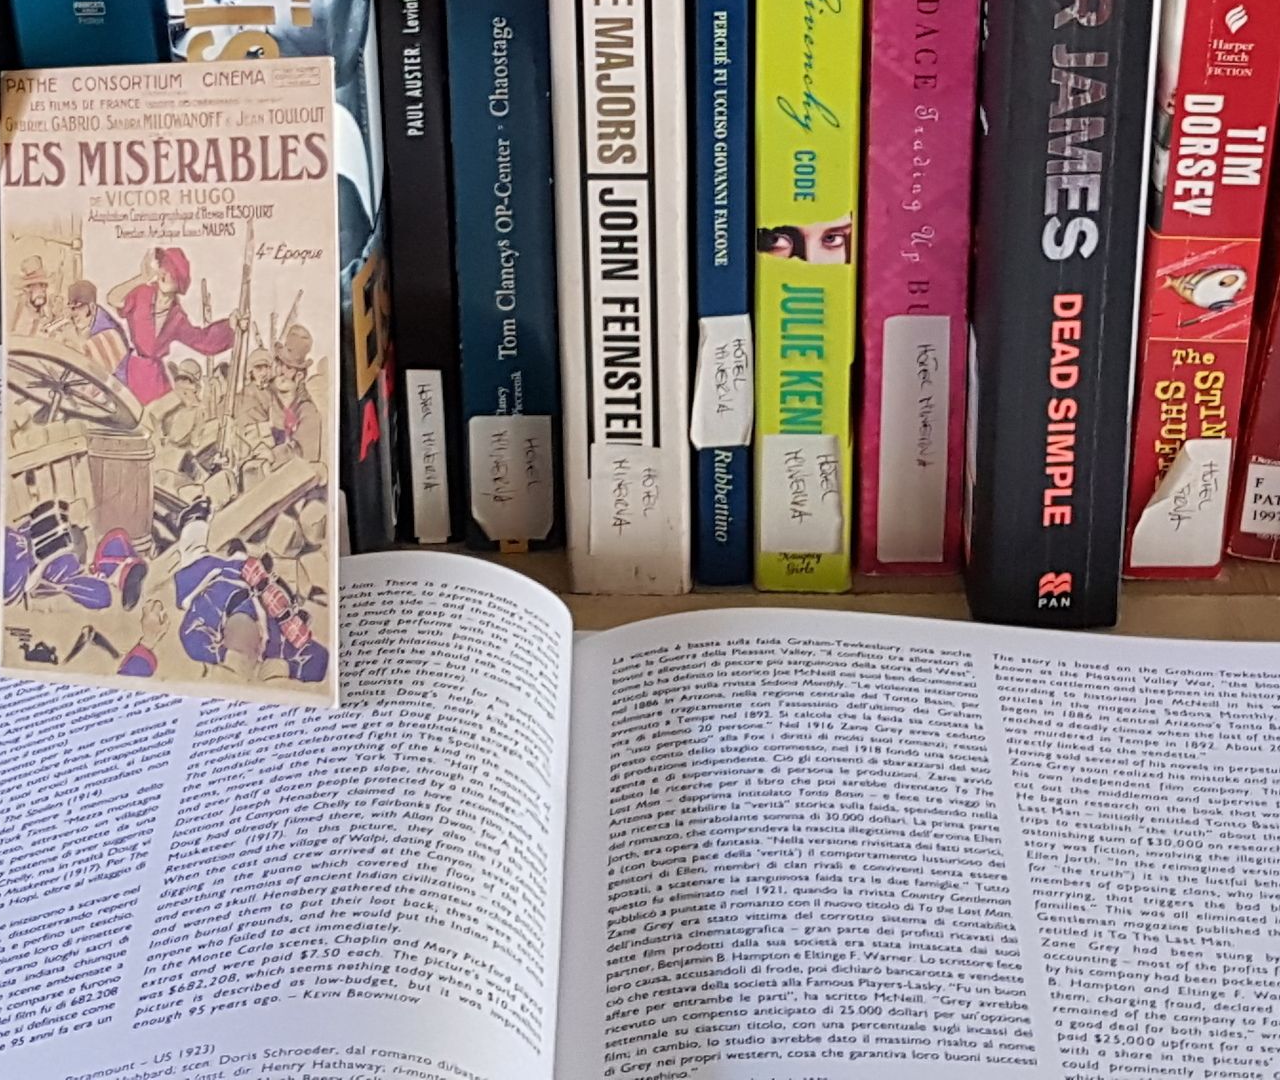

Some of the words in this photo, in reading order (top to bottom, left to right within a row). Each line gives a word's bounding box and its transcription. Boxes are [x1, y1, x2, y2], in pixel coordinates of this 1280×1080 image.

[489, 16, 512, 117] Chaostage
[712, 11, 731, 65] PERCHÉ
[1215, 52, 1249, 64] Torch
[72, 74, 183, 91] CONSORTIUM
[203, 70, 265, 87] CINEMA
[100, 99, 140, 108] FRANCE
[594, 17, 637, 166] MAJORS
[713, 68, 727, 86] FU
[143, 111, 223, 129] MILOWANOFF
[268, 106, 325, 125] TOULOUT
[407, 95, 424, 136] PAUL
[713, 89, 727, 139] UCCISO
[3, 142, 65, 187] LES
[79, 132, 329, 186] MISÉRABLES
[713, 142, 728, 206] GIOVANNI
[794, 149, 816, 203] CODE
[902, 106, 938, 212] Trading
[1042, 43, 1109, 261] JAMES
[1172, 94, 1224, 217] DORSEY
[1222, 126, 1267, 187] TIM
[105, 190, 170, 207] VICTOR
[179, 187, 235, 204] HUGO
[494, 138, 514, 234] OP-Center
[598, 187, 640, 281] JOHN
[713, 209, 728, 266] FALCONE
[496, 238, 519, 311] Clancys
[498, 318, 517, 361] Tom
[780, 282, 824, 361] JULIE
[1049, 294, 1084, 390] DEAD
[602, 296, 643, 446] FEINSTEI
[1172, 349, 1215, 367] The
[1043, 397, 1078, 528] SIMPLE
[714, 449, 735, 543] Rubbettino
[1038, 597, 1070, 609] PAN
[153, 1049, 175, 1065] US
